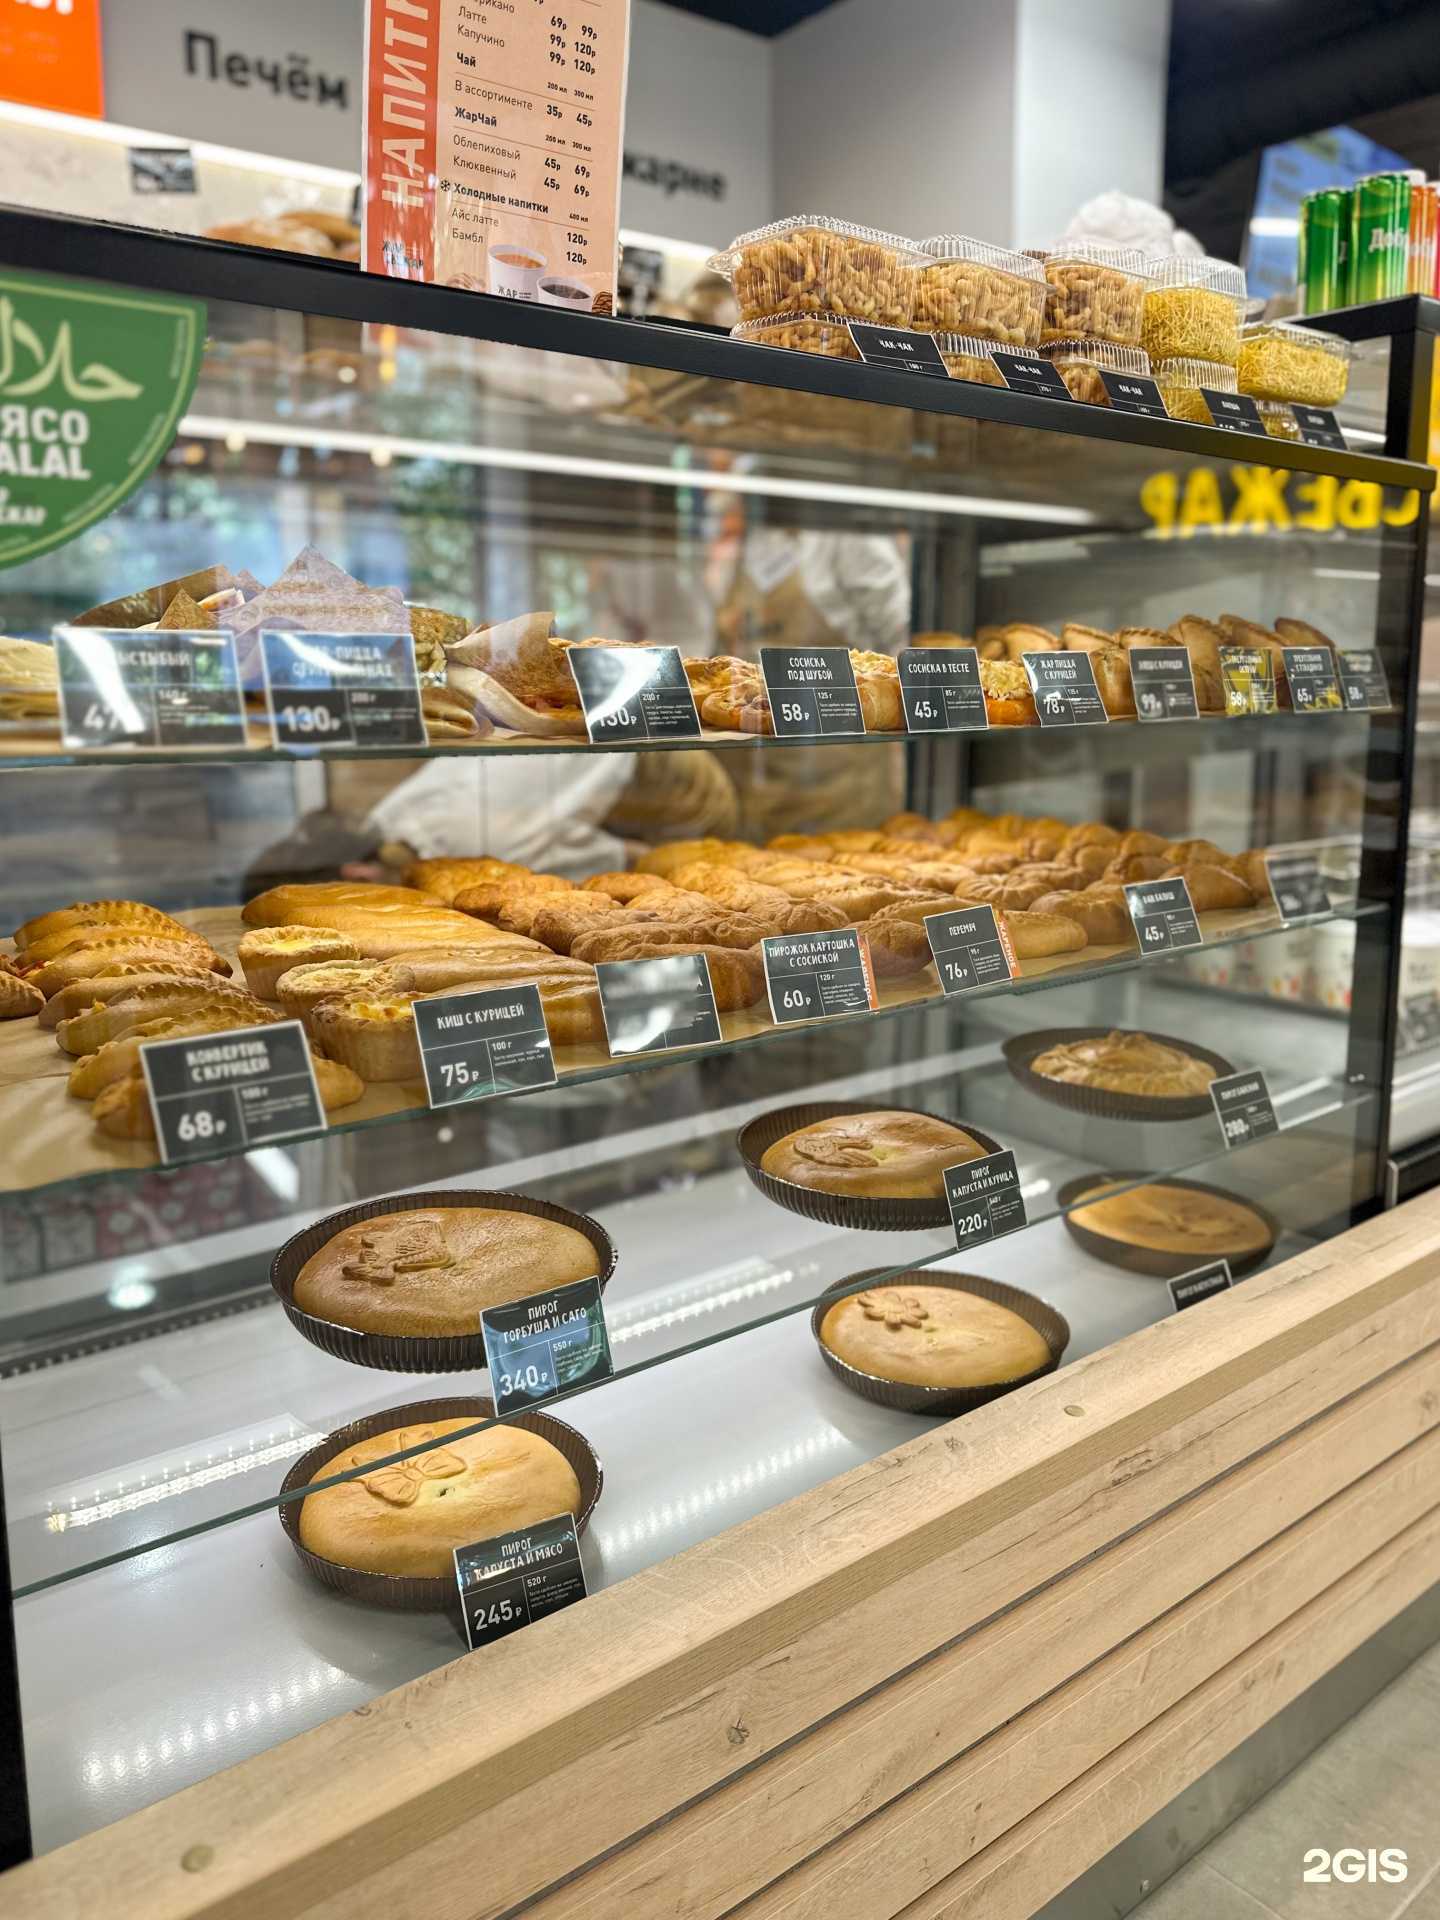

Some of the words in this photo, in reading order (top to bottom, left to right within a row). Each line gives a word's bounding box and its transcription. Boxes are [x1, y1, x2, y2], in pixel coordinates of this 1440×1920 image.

[458, 6, 487, 24] Латте
[457, 24, 505, 48] Капучино
[183, 28, 349, 109] Печём
[456, 52, 476, 67] Чай
[455, 80, 462, 91] В
[465, 84, 533, 110] ассортименте
[454, 106, 497, 128] ЖарЧай
[453, 134, 521, 161] Облепиховый
[453, 155, 517, 180] Клюквенный
[454, 182, 506, 204] Холодные
[508, 197, 549, 214] напитки
[452, 207, 470, 222] Айс
[473, 214, 500, 228] латте
[452, 228, 484, 244] Бамбл
[0, 404, 90, 445] ЯСО
[0, 440, 92, 480] ALAL
[789, 656, 827, 668] СОСИСКА
[908, 664, 942, 674] СОСИСКА
[948, 663, 970, 673] ТЕСТЕ
[787, 670, 806, 682] ПОД
[806, 668, 833, 680] ШУБОЙ
[768, 942, 810, 958] ПИРОЖОК
[811, 938, 856, 952] КАРТОШКА
[789, 957, 796, 968] С
[796, 951, 840, 967] СОСИСКОЙ
[437, 1014, 464, 1030] КИШ
[466, 1012, 474, 1024] С
[474, 1003, 525, 1023] КУРИЦЕЙ
[952, 1182, 982, 1199] КАПУСТА
[528, 1300, 560, 1320] ПИРОГ
[503, 1320, 551, 1344] ГОРБУША
[552, 1316, 560, 1328] И
[561, 1307, 588, 1324] САГО
[501, 1537, 532, 1557] ПИРОГ
[474, 1556, 526, 1580] КАПУСТА
[526, 1552, 534, 1564] И
[535, 1543, 563, 1560] МЯСО
